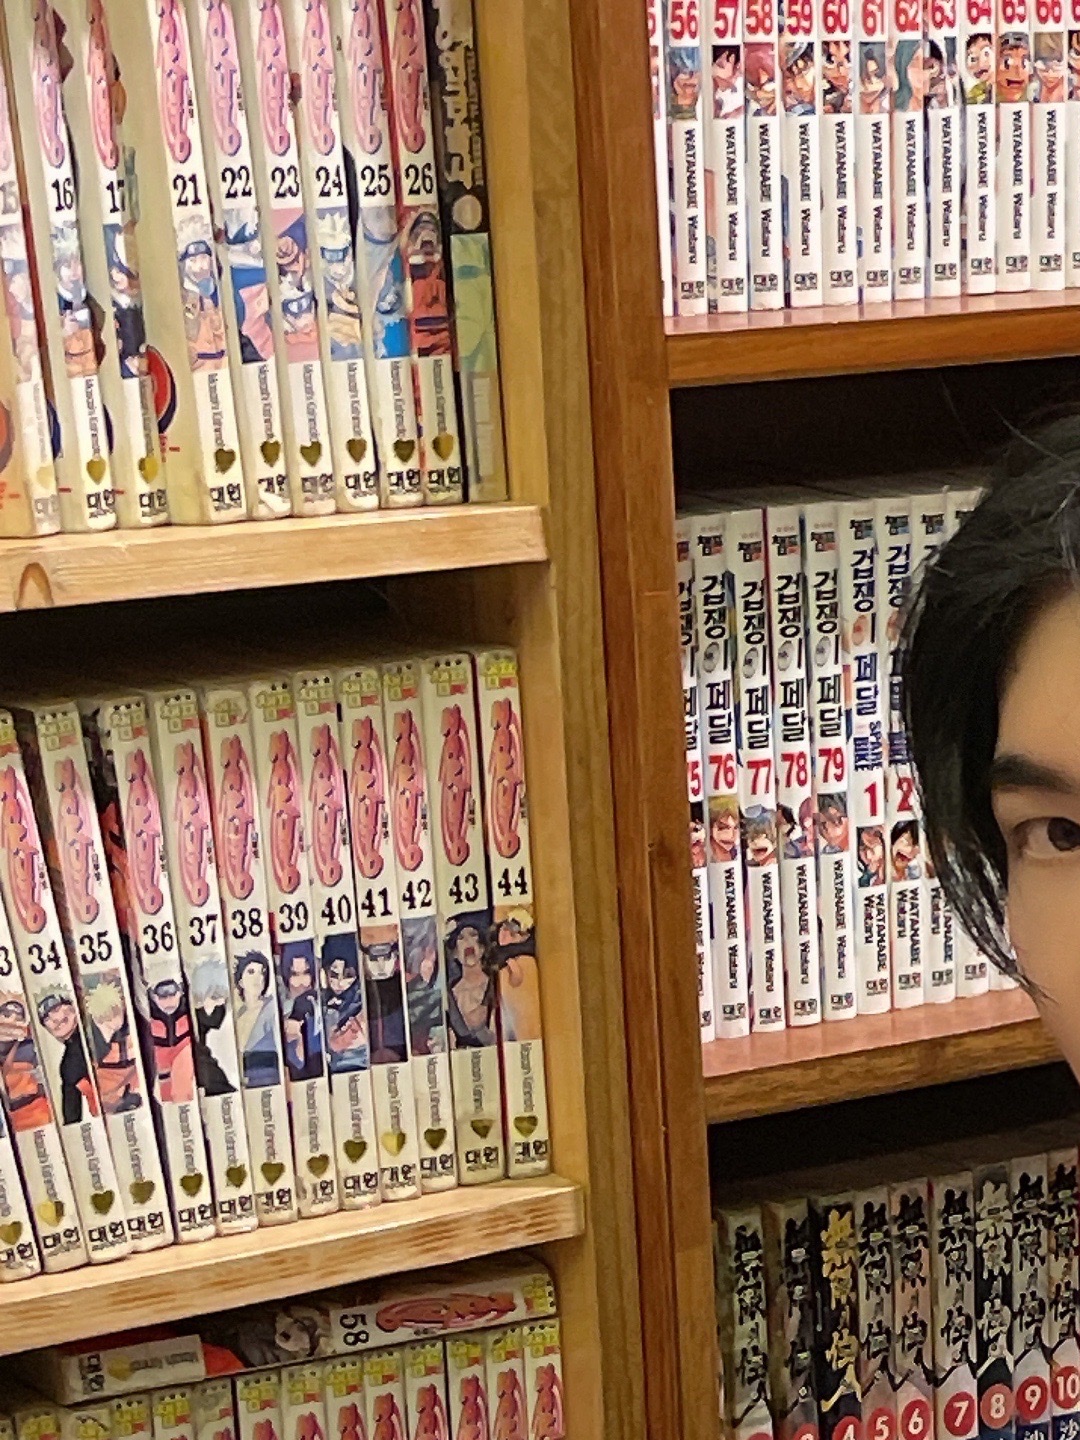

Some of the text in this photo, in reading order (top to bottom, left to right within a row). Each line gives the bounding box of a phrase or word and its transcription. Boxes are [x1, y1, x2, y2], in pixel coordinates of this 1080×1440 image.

[671, 0, 698, 39] 56
[714, 0, 738, 39] 57
[746, 0, 772, 37] 58
[786, 0, 812, 36] 59
[822, 0, 849, 34] 60
[862, 0, 884, 36] 61
[895, 0, 919, 32] 62
[51, 177, 74, 212] 16
[173, 174, 202, 207] 21
[221, 165, 253, 199] 22
[271, 164, 300, 199] 23
[315, 164, 344, 197] 24
[361, 164, 391, 197] 25
[404, 163, 434, 196] 26
[428, 466, 461, 485] 대원
[854, 652, 879, 716] 페달
[706, 680, 732, 745] 페달
[745, 685, 772, 750] 페달
[780, 678, 807, 743] 페달
[817, 674, 843, 738] 페달
[709, 753, 735, 790] 76
[747, 759, 772, 795] 77
[781, 751, 808, 788] 78
[818, 747, 845, 783] 79
[863, 781, 877, 817] 1
[896, 777, 914, 812] 2
[402, 879, 432, 910] 42
[449, 873, 479, 904] 43
[498, 866, 528, 896] 44
[279, 901, 309, 934] 39
[321, 894, 352, 926] 40
[361, 887, 393, 918] 41
[143, 921, 174, 954] 36
[189, 914, 218, 947] 37
[231, 908, 264, 940] 38
[28, 940, 62, 974] 34
[79, 931, 113, 965] 35
[420, 1153, 454, 1172] 대원
[89, 1221, 125, 1243] 대원
[339, 1313, 369, 1348] 58
[1024, 1384, 1041, 1411] 9
[1057, 1374, 1080, 1400] 10
[908, 1408, 924, 1434] 6
[954, 1400, 969, 1428] 7
[990, 1393, 1005, 1419] 8
